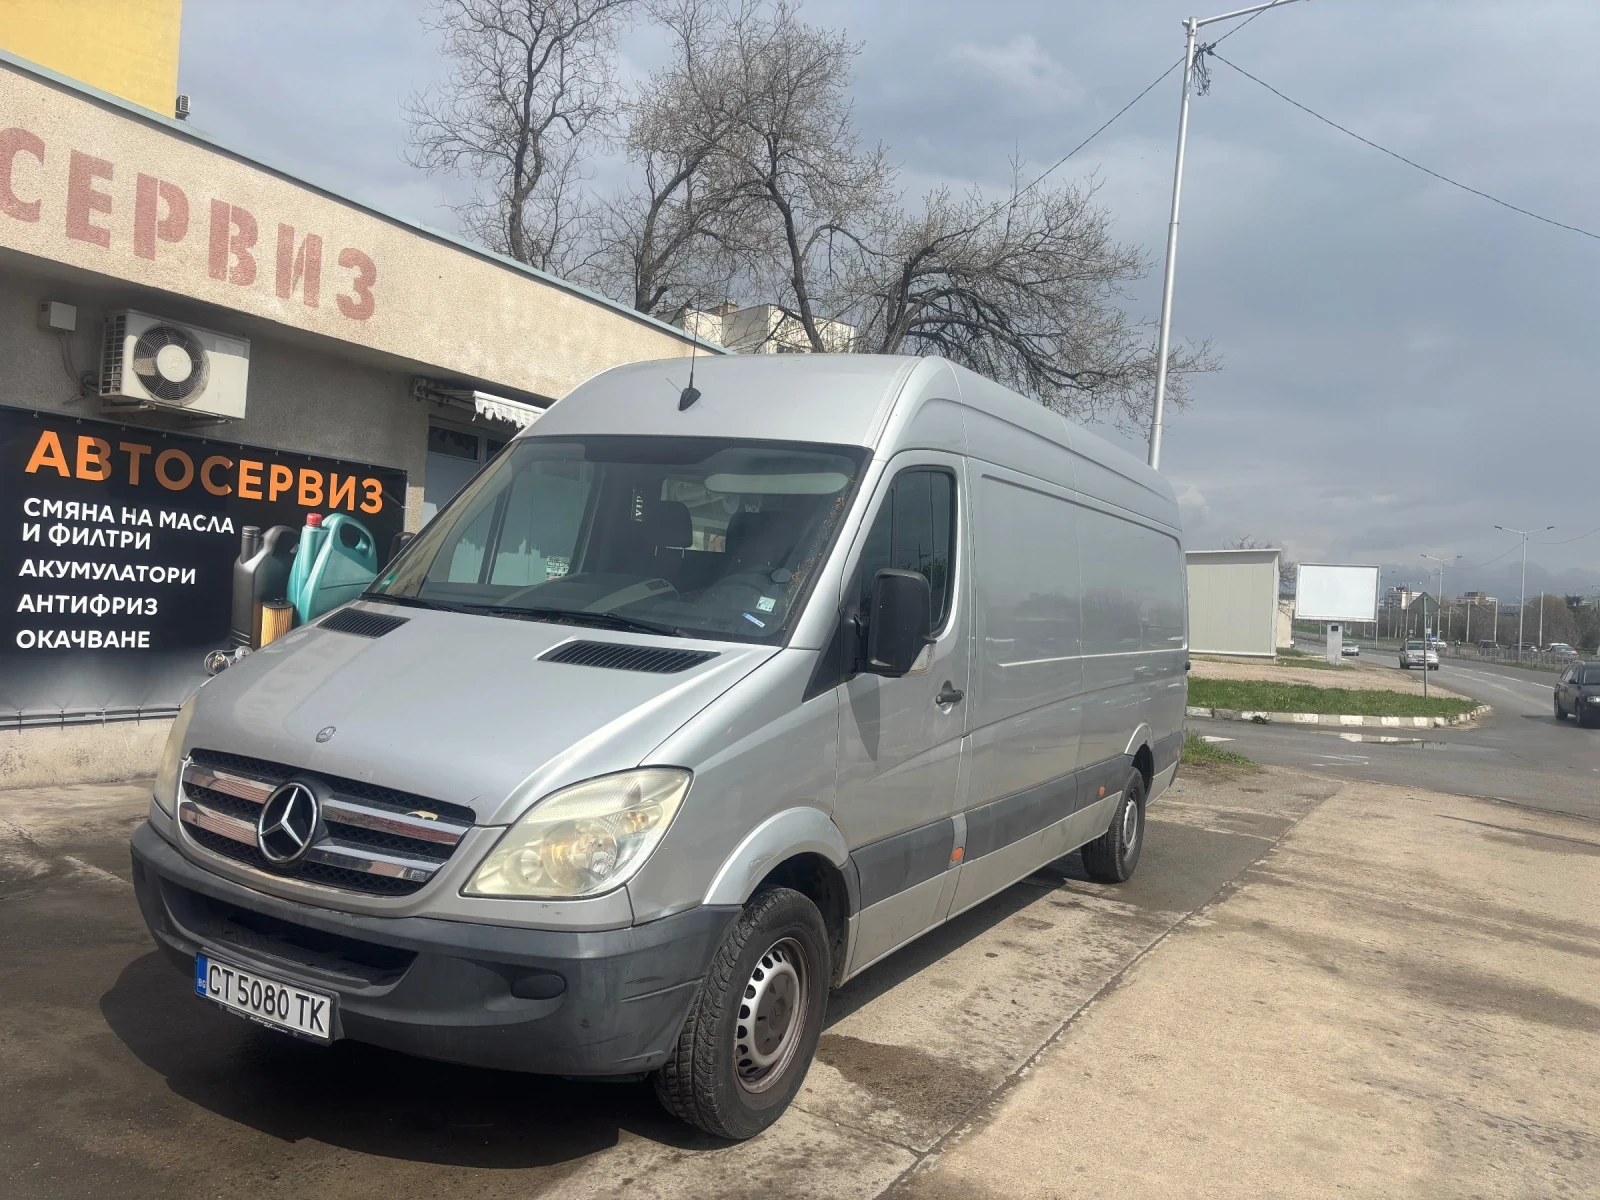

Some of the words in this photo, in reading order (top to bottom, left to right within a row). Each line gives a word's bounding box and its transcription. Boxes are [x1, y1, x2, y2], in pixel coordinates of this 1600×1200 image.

[0, 127, 377, 321] СЕРВИЗ
[25, 430, 384, 514] АВТОСЕРВИЗ
[23, 497, 113, 525] СМЯНА
[121, 508, 154, 528] НА
[159, 511, 235, 534] МАСЛА
[22, 523, 41, 543] И
[48, 524, 151, 550] ФИЛТРИ
[18, 558, 196, 585] АКУМУЛАТОРИ
[16, 593, 159, 617] АНТИФРИЗ
[15, 629, 151, 649] ОКАЧВАНЕ
[198, 978, 206, 989] BG
[238, 974, 290, 1020] 5080
[295, 993, 326, 1033] TK
